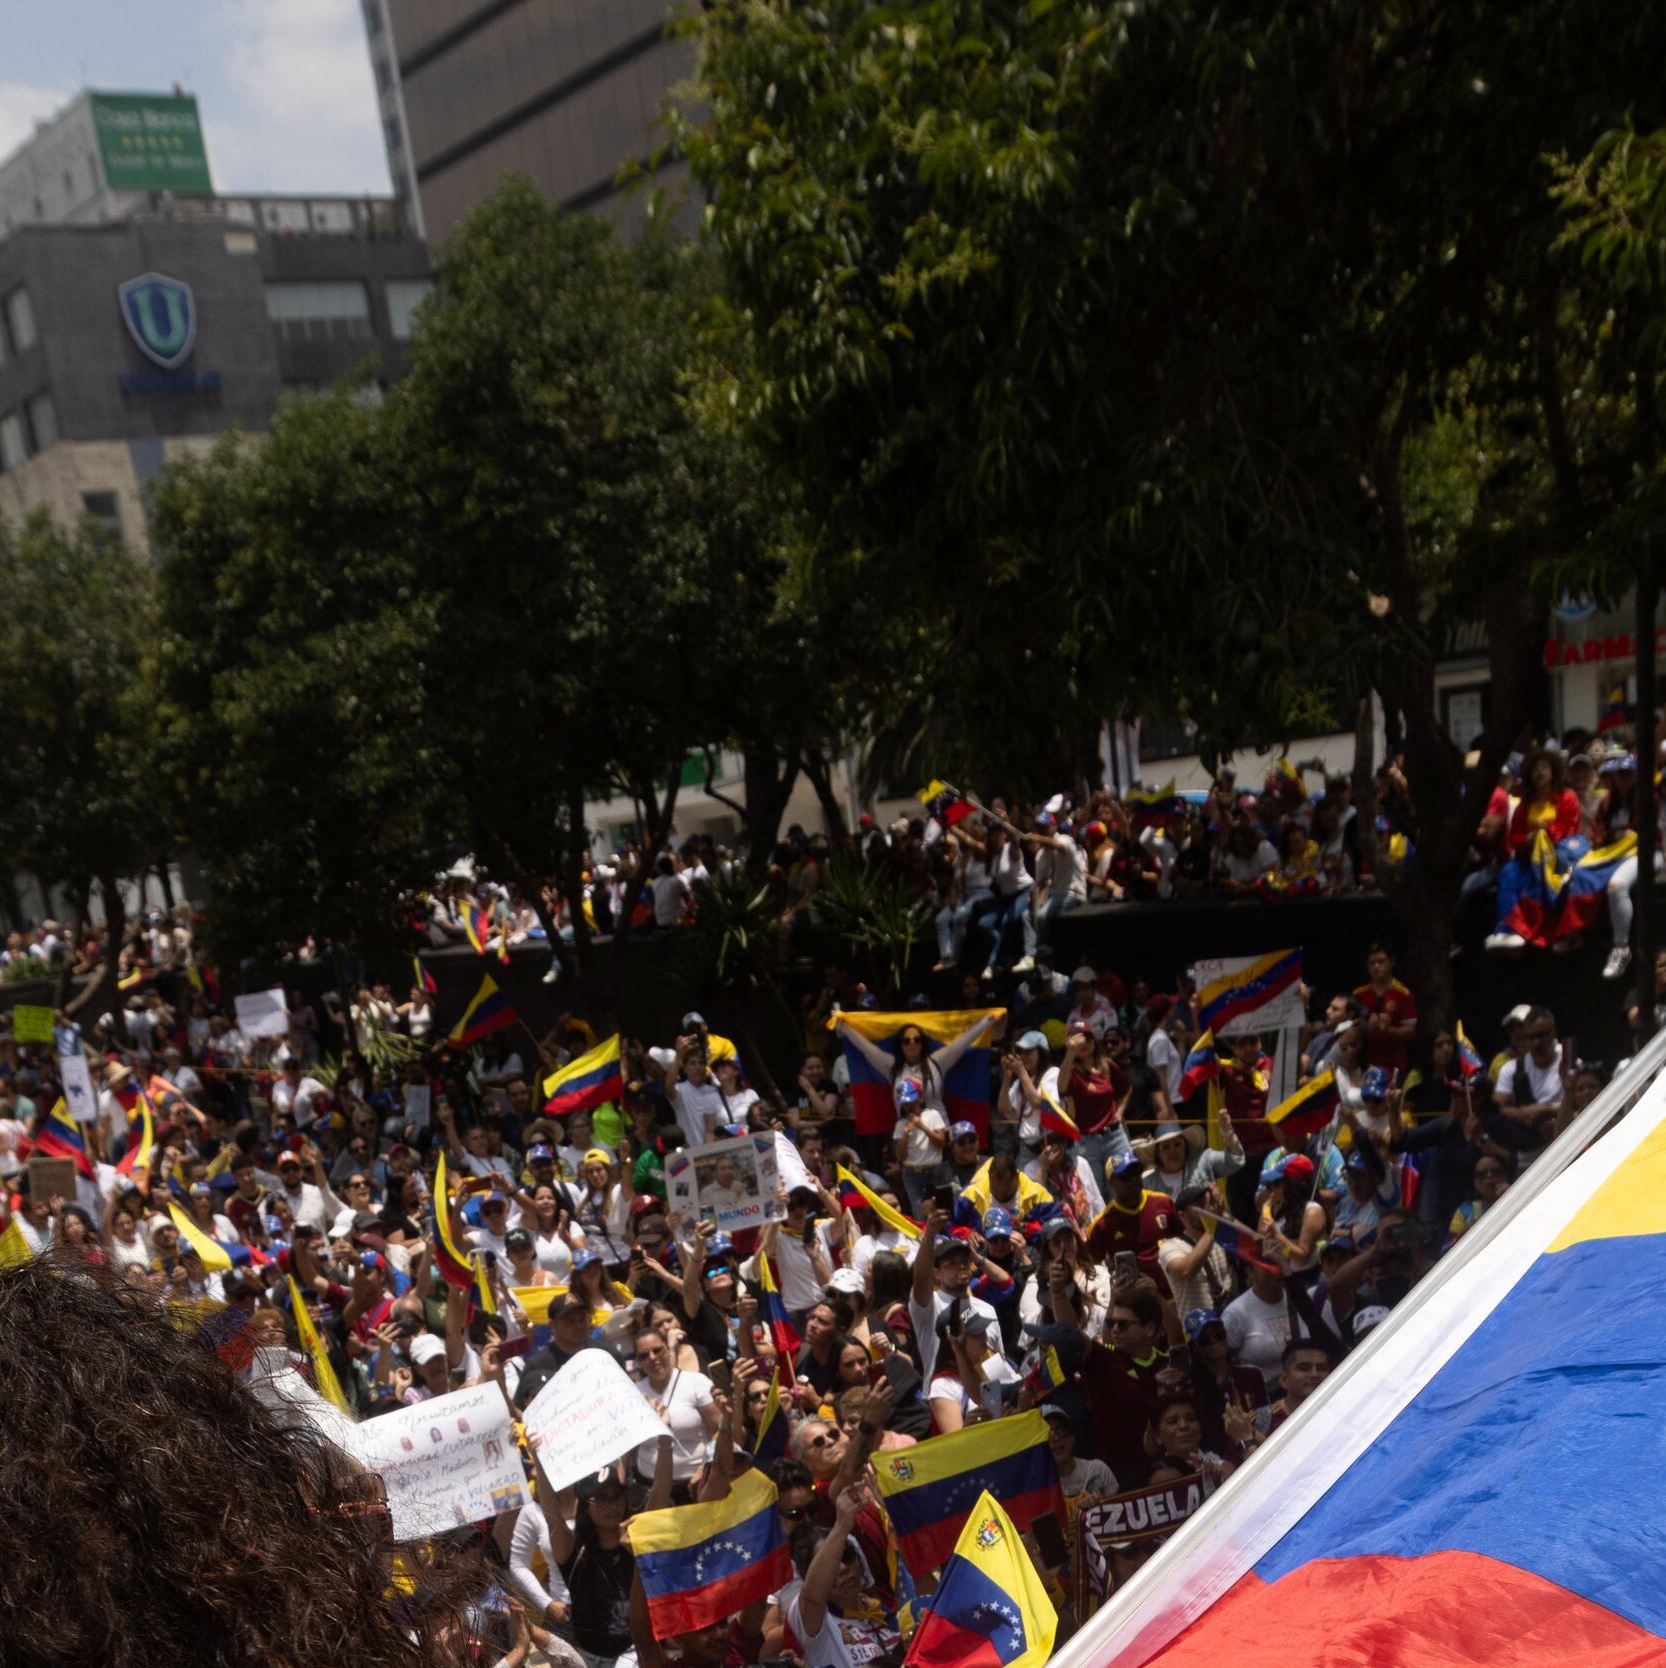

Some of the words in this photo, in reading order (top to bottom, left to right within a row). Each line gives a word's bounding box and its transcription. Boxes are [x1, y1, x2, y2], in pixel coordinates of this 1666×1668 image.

[132, 285, 187, 353] U
[718, 1204, 760, 1222] MUNDO
[541, 1392, 617, 1449] DICTADURA
